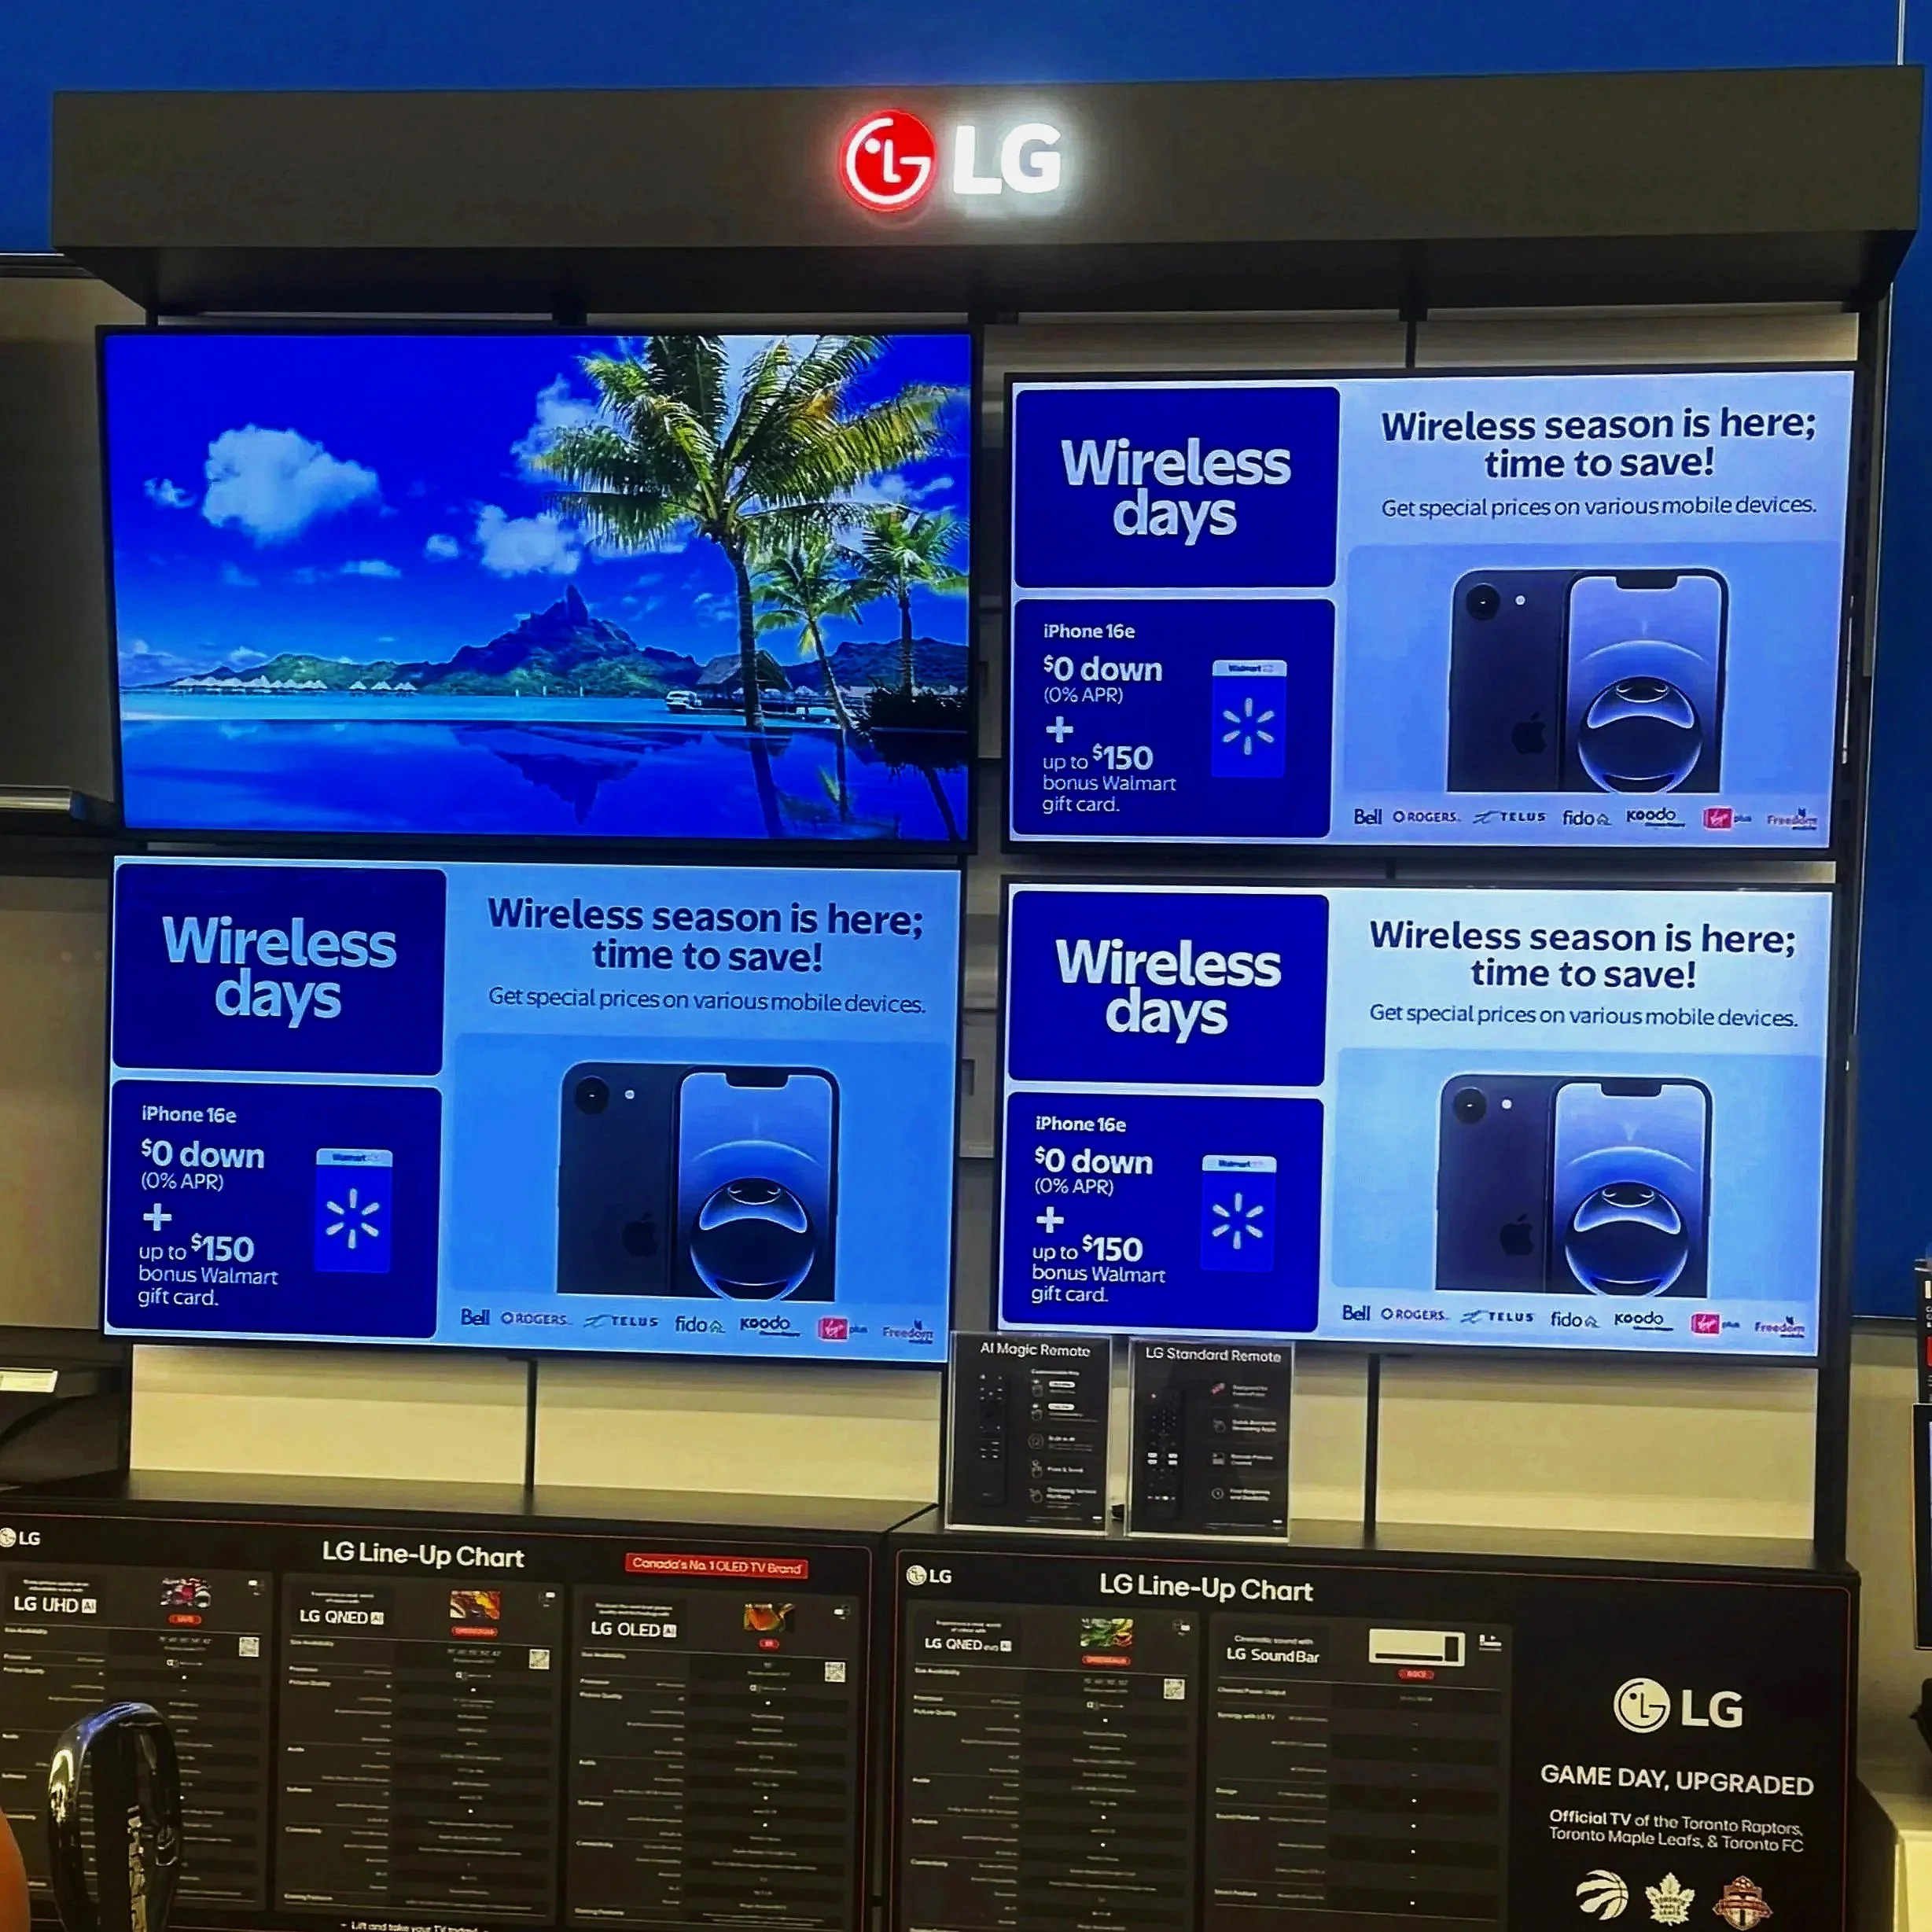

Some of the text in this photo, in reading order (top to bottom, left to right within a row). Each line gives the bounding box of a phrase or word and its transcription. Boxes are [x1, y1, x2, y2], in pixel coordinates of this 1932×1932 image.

[953, 123, 1062, 194] LG
[1382, 407, 1816, 441] Wireless season is here;
[1062, 437, 1292, 485] Wireless
[1485, 447, 1713, 478] time to save!
[1113, 488, 1238, 546] days
[1382, 496, 1817, 520] Get special prices on various mobile devices.
[1043, 624, 1135, 639] iPhone 16e
[1043, 656, 1163, 682] $0 down
[1044, 687, 1124, 705] (0% APR)
[1043, 744, 1154, 773] up to $150
[1043, 775, 1176, 792] bonus Walmart
[1043, 796, 1120, 815] gift card.
[1354, 808, 1382, 826] Bell
[1501, 811, 1546, 822] TELUS
[1563, 810, 1595, 826] fido
[488, 897, 924, 940] Wireless season is here;
[162, 916, 396, 968] Wireless
[1370, 920, 1795, 957] Wireless season is here;
[591, 938, 822, 973] time to save!
[1056, 938, 1282, 987] Wireless
[1470, 957, 1695, 988] time to save!
[215, 968, 341, 1028] days
[489, 987, 926, 1014] Get special prices on various mobile devices.
[1106, 986, 1227, 1043] days
[1370, 1004, 1798, 1028] Get special prices on various mobile devices.
[142, 1106, 237, 1124] iPhone 16e
[1036, 1116, 1126, 1132] iPhone 16e
[142, 1139, 264, 1168] $0 down
[1035, 1146, 1153, 1175] $0 down
[142, 1173, 224, 1191] (0% APR)
[1035, 1179, 1113, 1197] (0% APR)
[140, 1232, 254, 1262] up to $150
[1032, 1235, 1143, 1262] up to $150
[139, 1266, 278, 1285] bonus Walmart
[1032, 1265, 1165, 1283] bonus Walmart
[138, 1289, 219, 1307] gift card.
[1032, 1286, 1109, 1304] gift card.
[461, 1308, 490, 1327] Bell
[611, 1316, 658, 1327] TELUS
[1343, 1305, 1370, 1321] Bell
[1489, 1312, 1533, 1323] TELUS
[1551, 1312, 1582, 1327] fido
[675, 1316, 707, 1333] fido
[997, 1343, 1037, 1357] Magic
[1040, 1345, 1091, 1357] Remote
[1146, 1348, 1281, 1363] LG Standard Remote
[19, 1532, 40, 1546] LG
[322, 1540, 524, 1570] LG Line-Up Chart
[634, 1558, 687, 1570] Canada's
[717, 1562, 749, 1573] OLED
[751, 1562, 765, 1573] TV
[768, 1563, 800, 1574] Brand
[929, 1570, 952, 1584] LG
[1100, 1573, 1314, 1603] LG Line-Up Chart
[14, 1596, 37, 1611] LG
[42, 1597, 79, 1613] UHD
[300, 1610, 368, 1624] LG QNED
[591, 1621, 661, 1637] LG OLED
[925, 1638, 983, 1650] LG QNED
[1227, 1647, 1246, 1660] LG
[1682, 1689, 1743, 1728] LG
[1541, 1765, 1814, 1796] GAME DAY, UPGRADED
[1550, 1809, 1803, 1837] Official TV of the Toronto Raptors,
[1550, 1827, 1804, 1852] Toronto Maple Leafs, & Toronto FC
